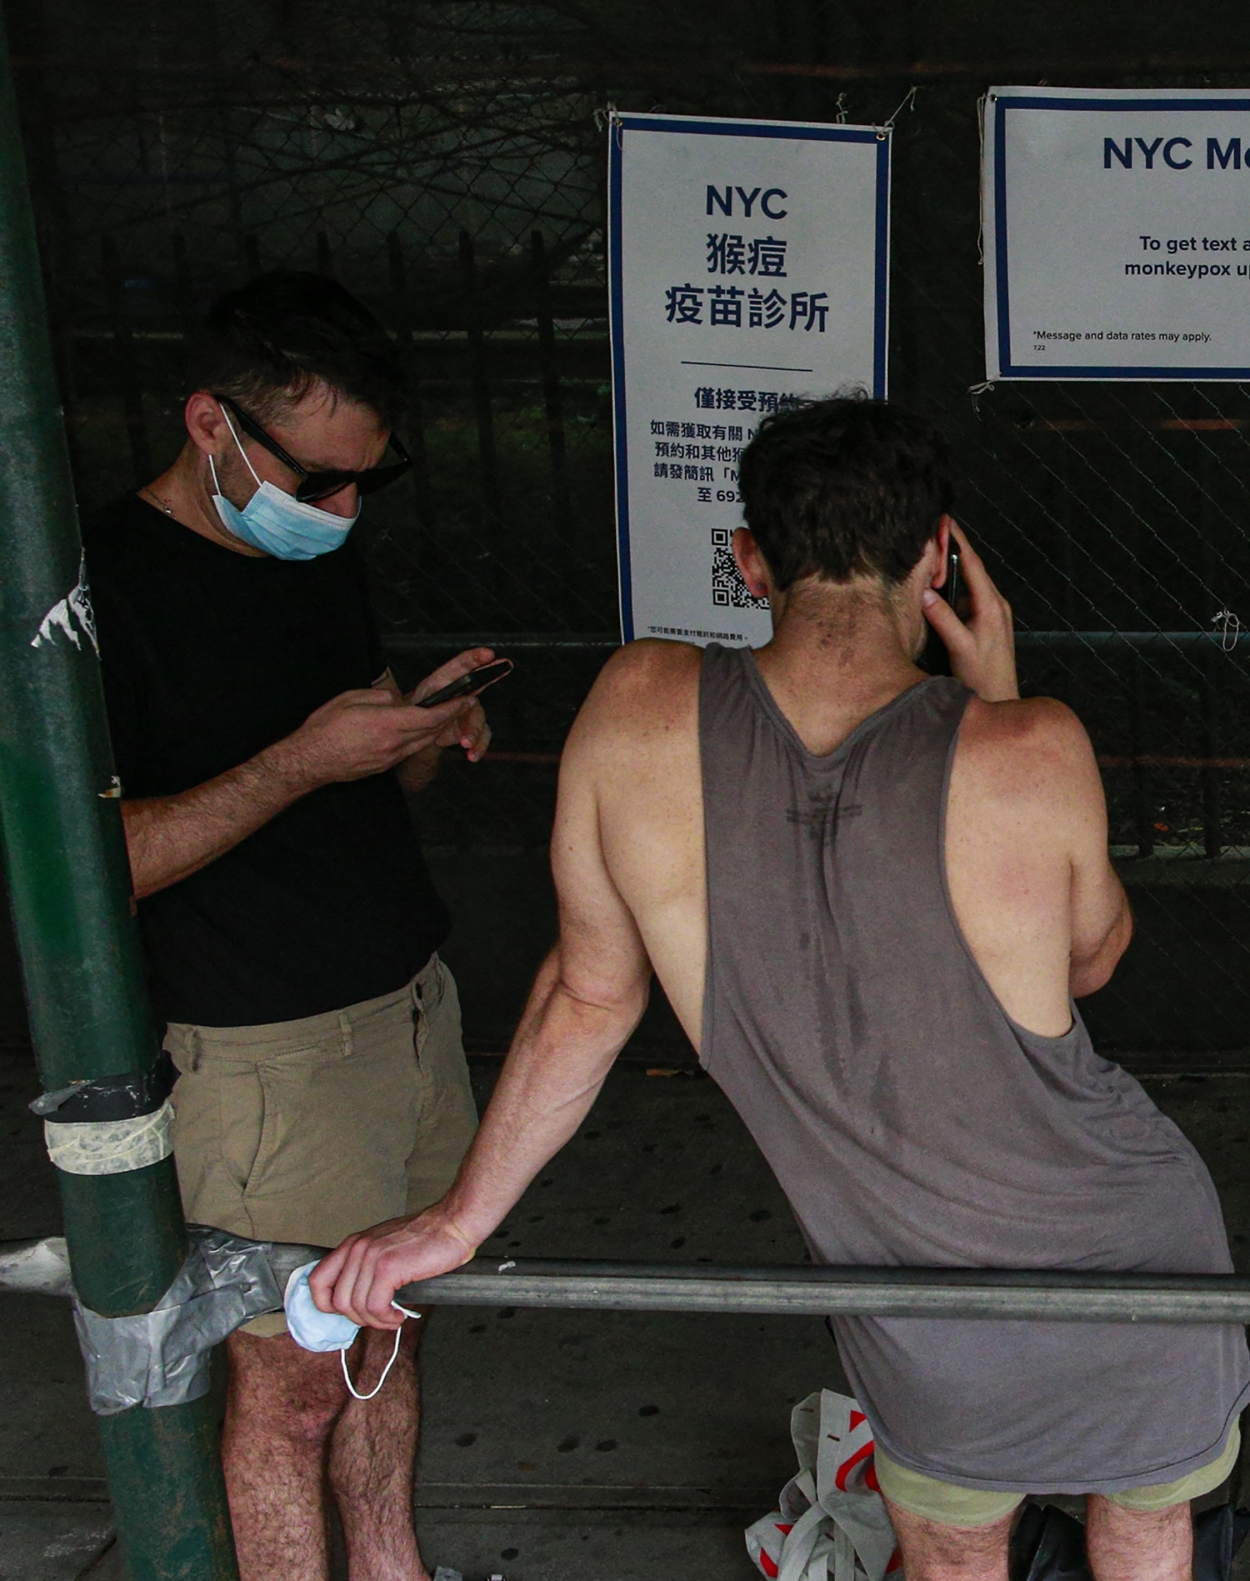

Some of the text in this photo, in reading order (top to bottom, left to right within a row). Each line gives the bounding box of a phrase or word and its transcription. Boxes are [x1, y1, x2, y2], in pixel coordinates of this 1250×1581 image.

[1103, 136, 1193, 171] NYC
[706, 184, 788, 220] NYC
[705, 232, 788, 278] 猴痘
[1139, 235, 1161, 251] To
[1166, 236, 1197, 255] get
[1201, 237, 1238, 252] text
[1124, 260, 1231, 280] monkeypox
[664, 282, 830, 333] 疫苗診所
[1084, 331, 1104, 340] and
[1106, 331, 1129, 341] data
[1131, 332, 1156, 341] rates
[1158, 333, 1180, 343] may
[1182, 332, 1212, 343] apply.
[650, 419, 743, 442] 如需獲取有關
[697, 486, 713, 503] 至
